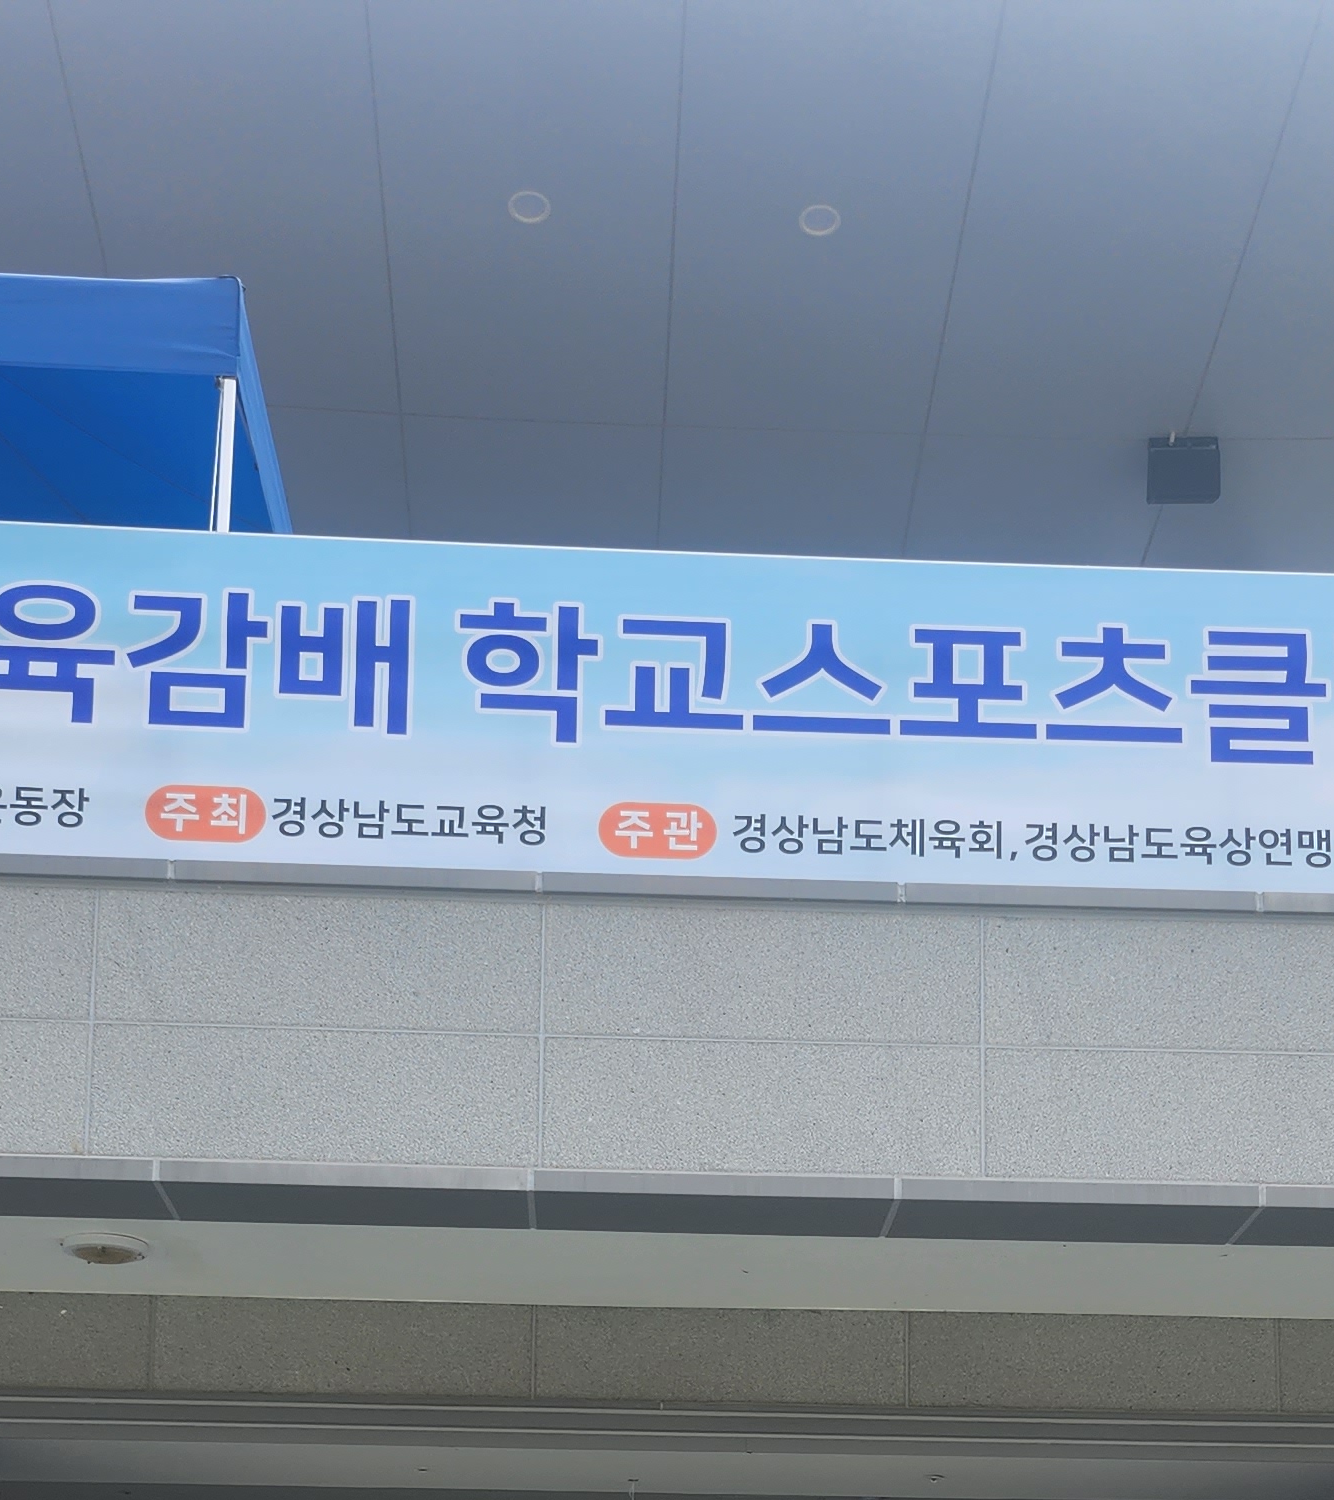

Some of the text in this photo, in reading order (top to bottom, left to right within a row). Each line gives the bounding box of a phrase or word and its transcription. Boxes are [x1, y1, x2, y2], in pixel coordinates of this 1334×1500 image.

[159, 794, 547, 847] 주최 경상남도교육청
[615, 808, 704, 852] 주관
